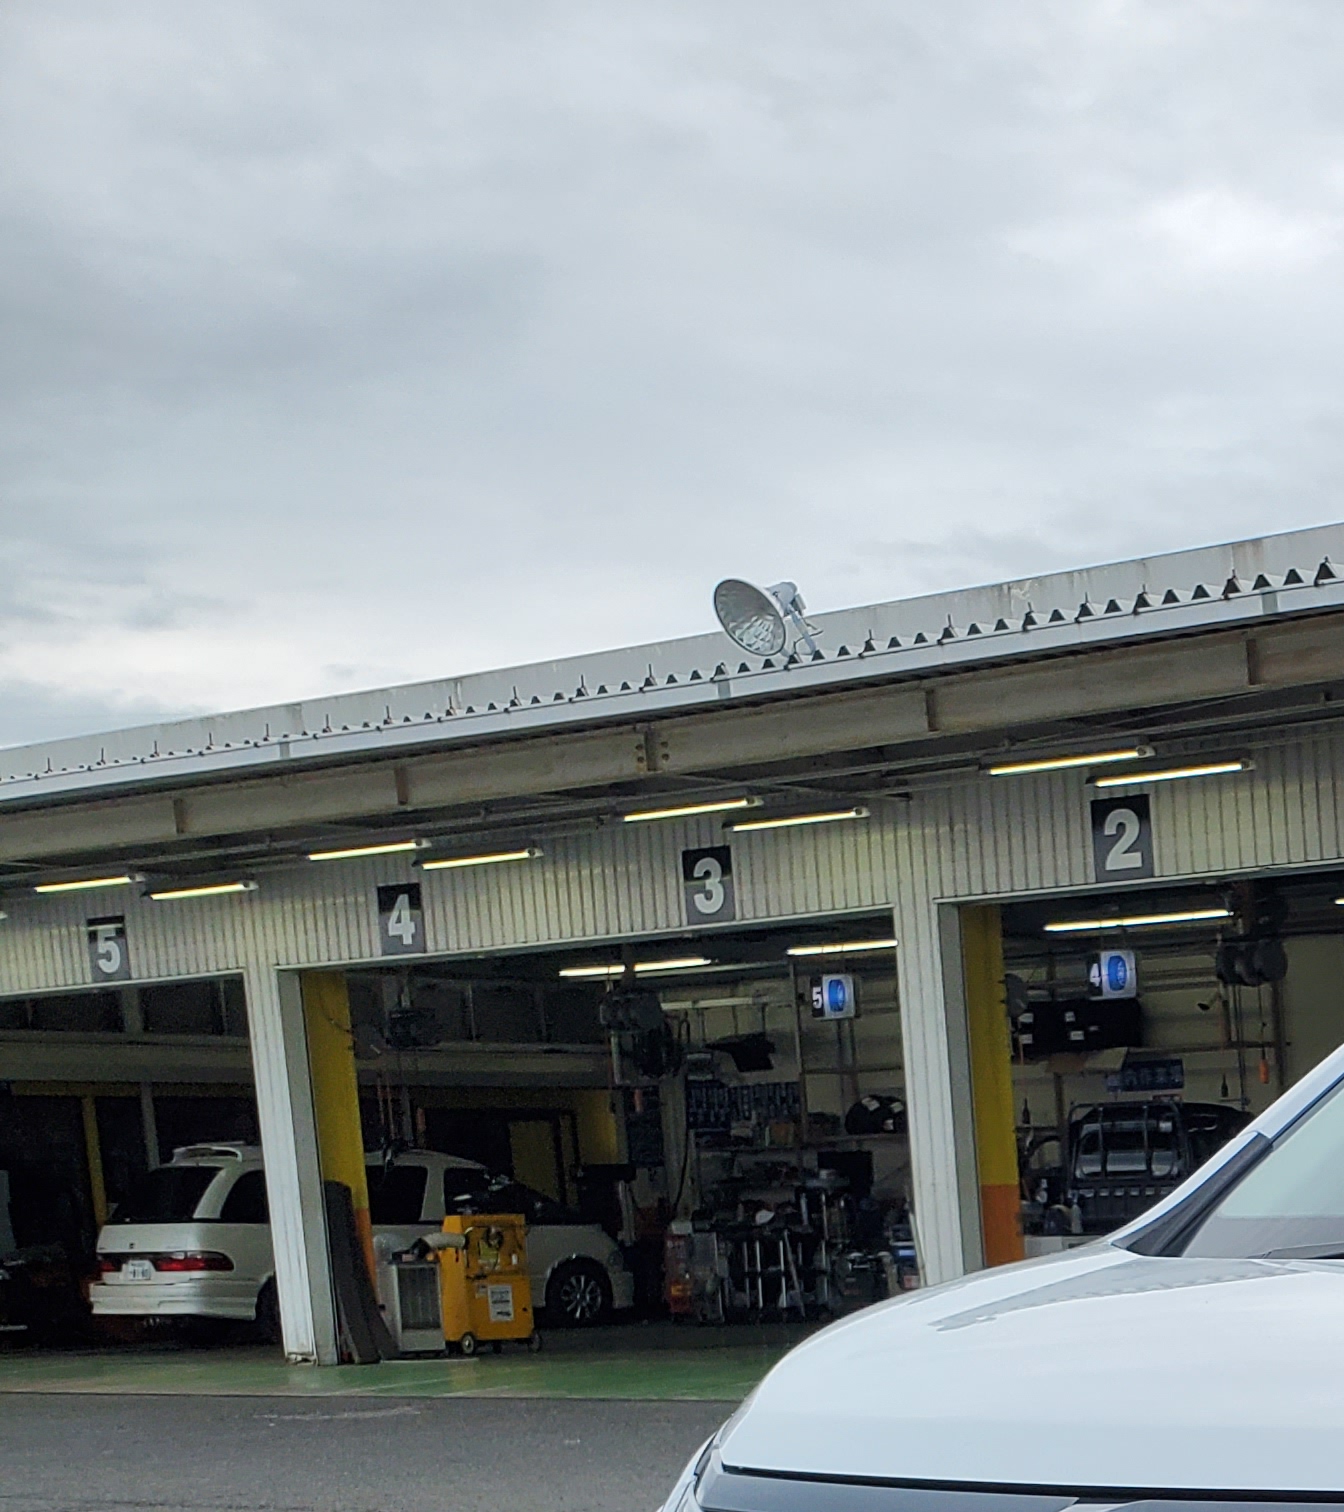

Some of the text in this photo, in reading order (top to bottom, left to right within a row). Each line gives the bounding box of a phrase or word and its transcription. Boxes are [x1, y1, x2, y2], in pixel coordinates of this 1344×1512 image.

[1103, 808, 1144, 871] 2
[694, 856, 725, 915] 3
[388, 893, 416, 946] 4
[96, 924, 121, 974] 5
[812, 986, 823, 1009] 5
